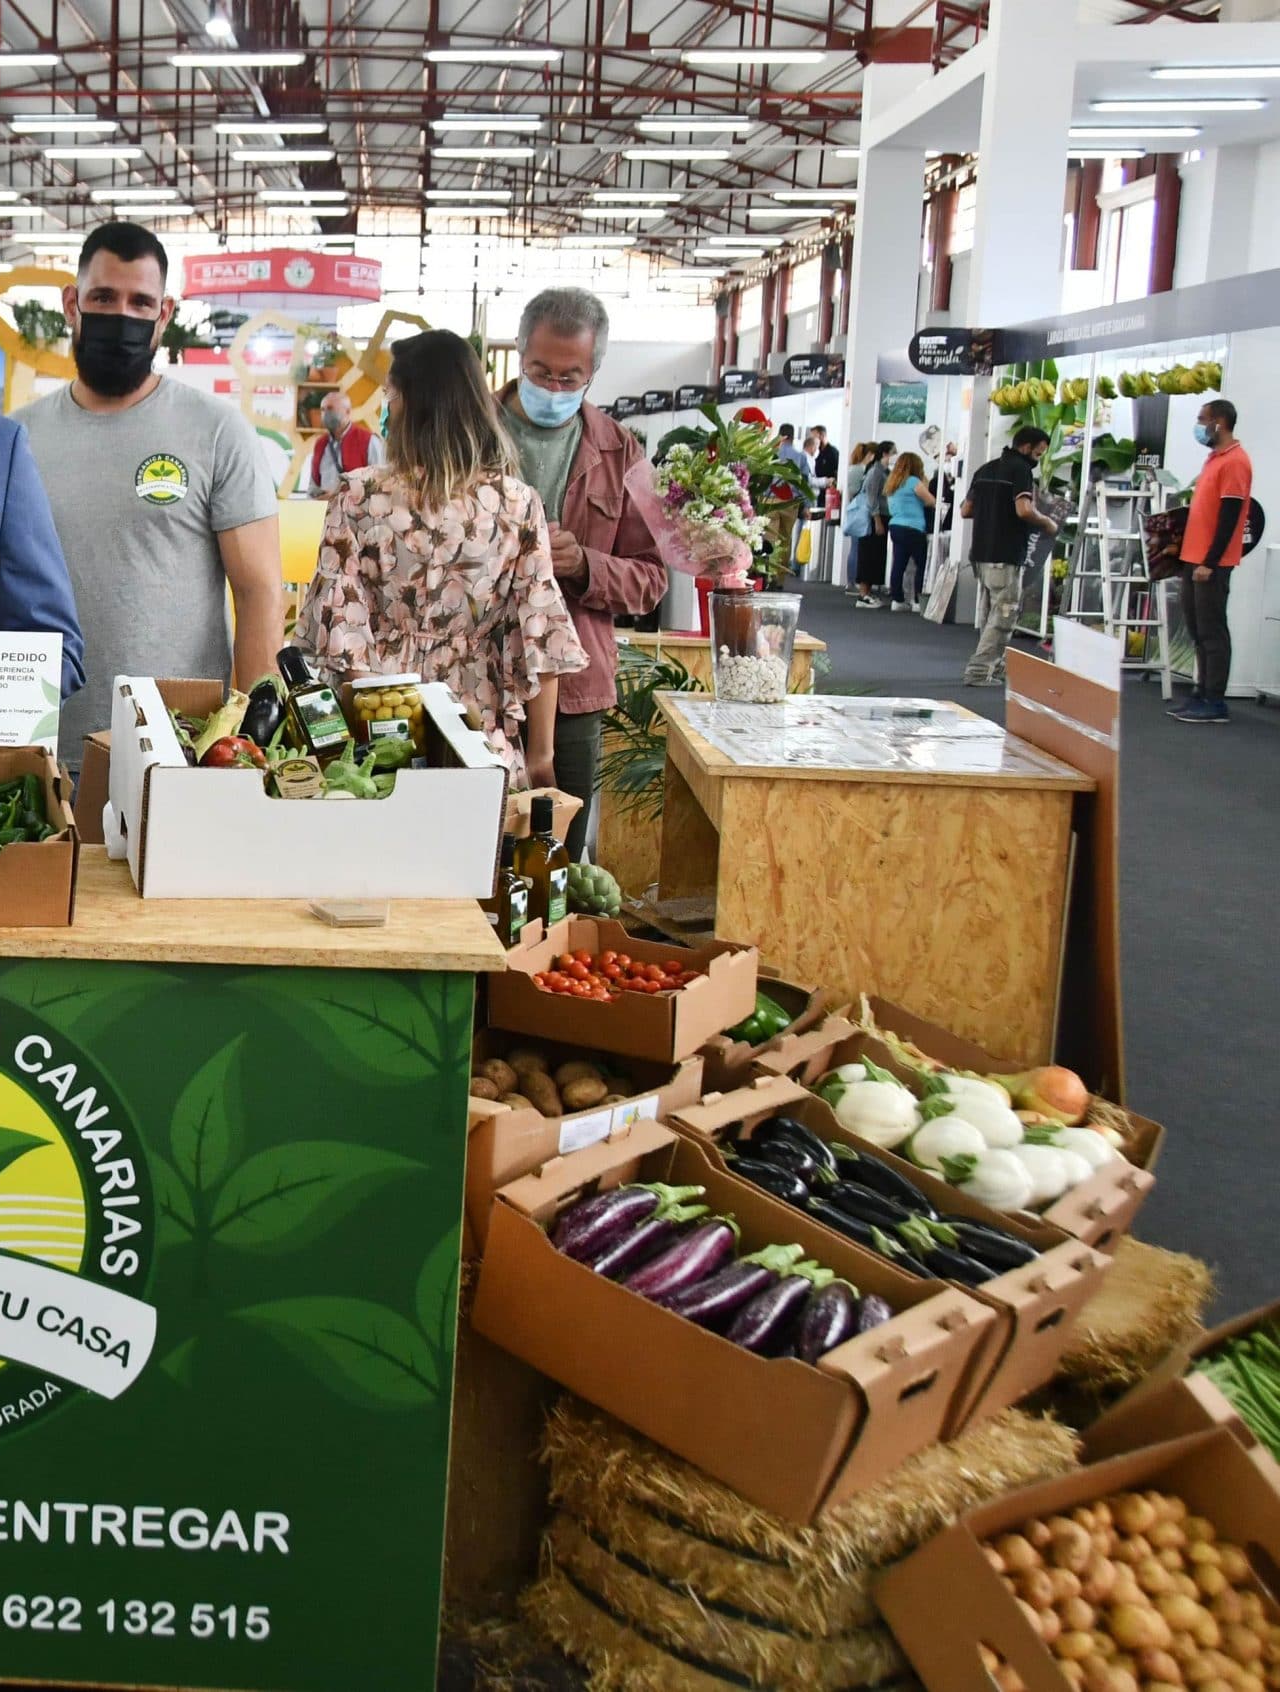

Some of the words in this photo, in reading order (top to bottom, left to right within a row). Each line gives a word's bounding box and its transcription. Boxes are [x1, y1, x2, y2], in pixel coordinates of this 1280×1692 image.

[202, 264, 248, 278] SPAR
[1, 652, 47, 662] PEDIDO
[14, 1034, 142, 1277] CANARIAS
[36, 1305, 131, 1369] CASA
[2, 1594, 82, 1631] 622
[97, 1599, 176, 1636] 132
[190, 1603, 270, 1640] 515
